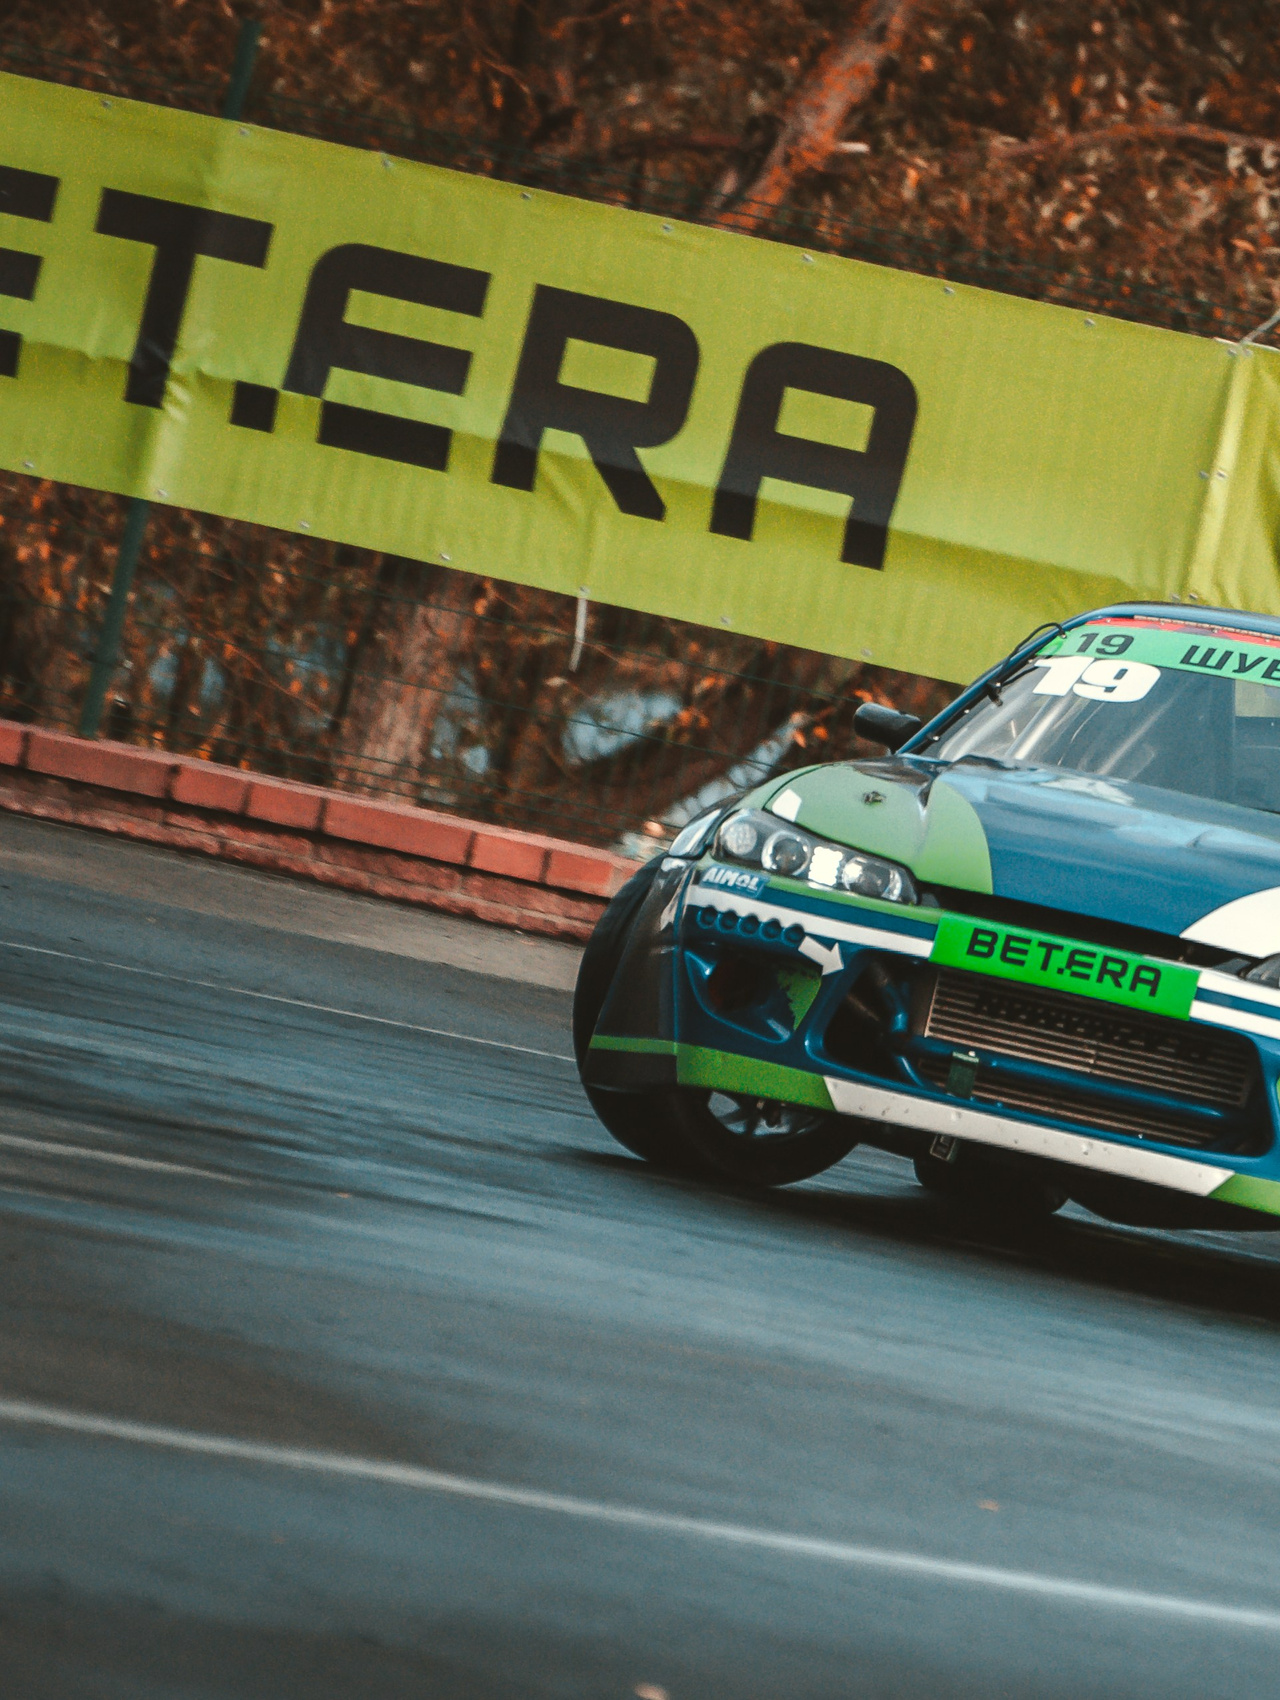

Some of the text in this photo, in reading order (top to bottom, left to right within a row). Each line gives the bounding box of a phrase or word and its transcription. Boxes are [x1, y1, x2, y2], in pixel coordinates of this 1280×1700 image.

[1076, 632, 1135, 656] 19
[1032, 655, 1162, 703] 19
[702, 866, 760, 893] AIMOL
[966, 928, 1162, 998] BET.ERA
